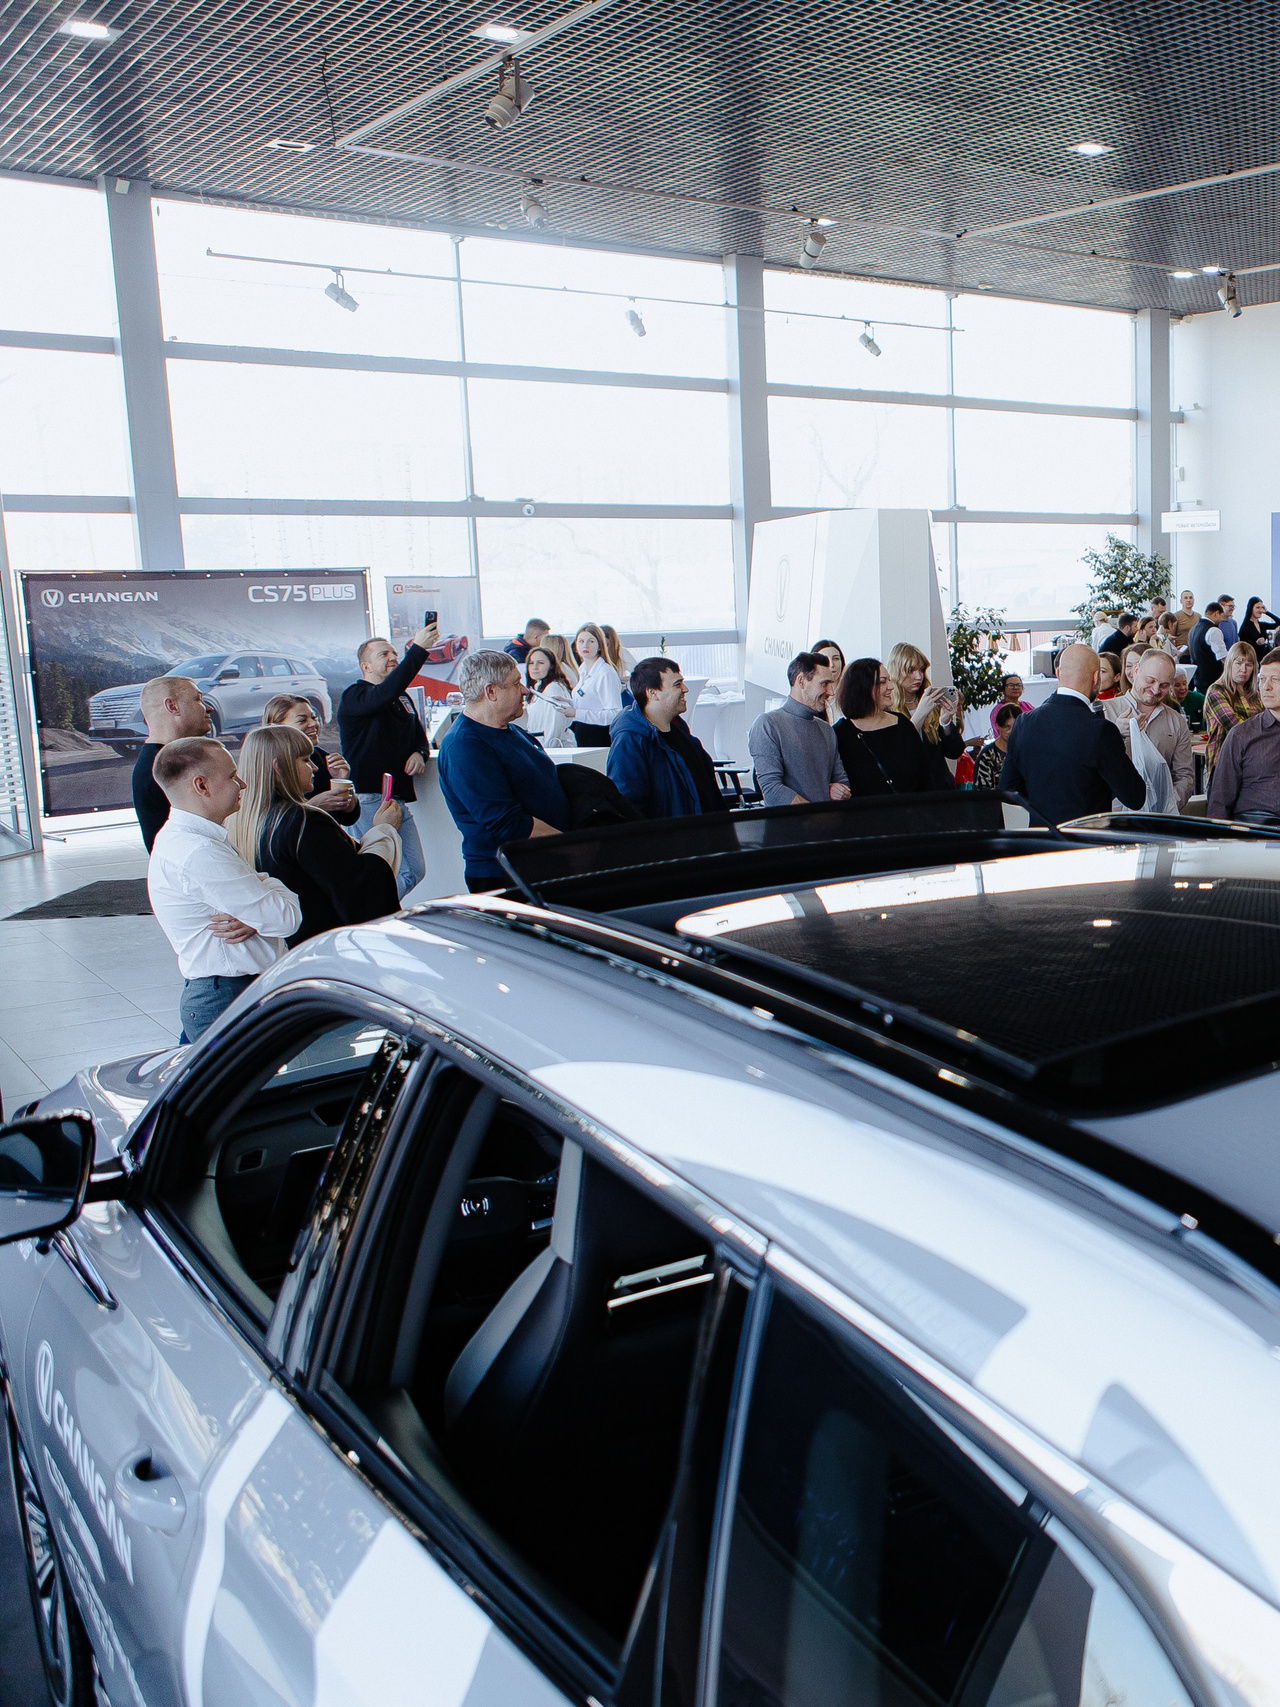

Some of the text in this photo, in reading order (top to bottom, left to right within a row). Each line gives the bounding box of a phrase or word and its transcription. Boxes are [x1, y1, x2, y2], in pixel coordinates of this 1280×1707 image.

[68, 591, 159, 603] CHANGAN
[248, 585, 355, 603] CS75 PLUS
[764, 637, 794, 660] CHANGAN
[53, 1388, 135, 1587] CHANGAN
